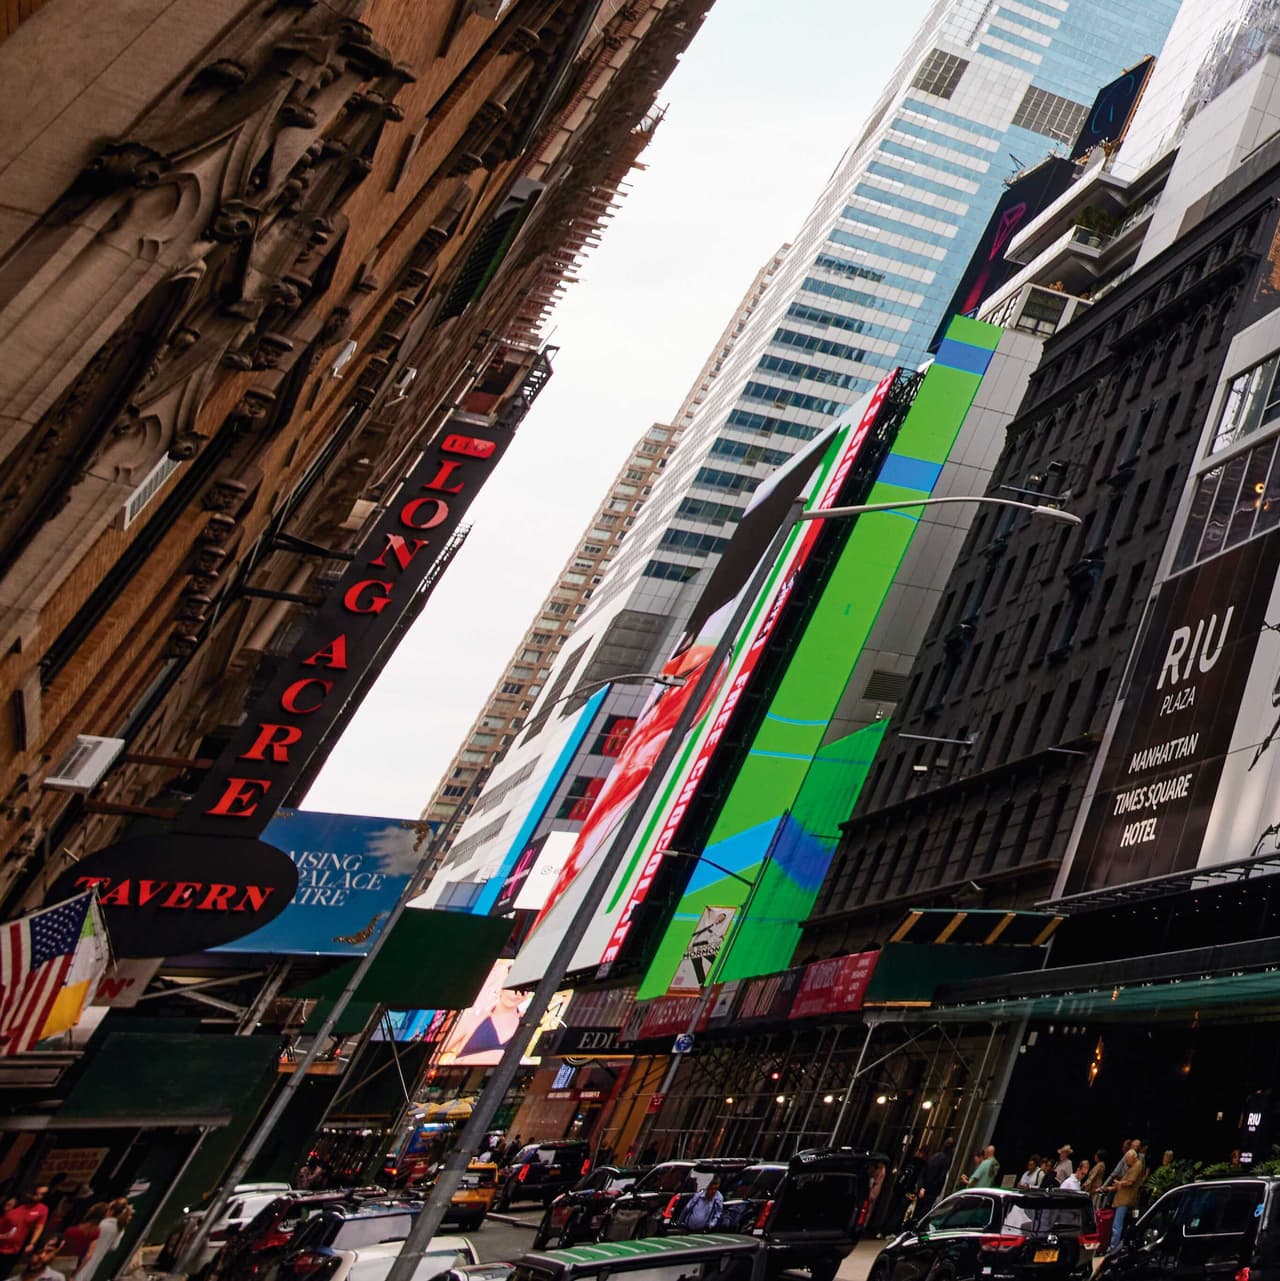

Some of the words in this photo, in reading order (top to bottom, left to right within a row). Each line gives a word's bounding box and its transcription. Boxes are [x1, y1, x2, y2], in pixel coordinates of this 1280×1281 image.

[343, 460, 464, 615] LONG
[1156, 606, 1234, 690] RIU
[1160, 686, 1196, 717] PLAZA
[206, 633, 349, 817] ACRE
[1128, 732, 1199, 774] MANHATTAN
[1113, 786, 1146, 816] TIMES
[1145, 773, 1193, 810] SQUARE
[1120, 817, 1157, 848] HOTEL
[73, 876, 275, 912] TAVERN
[683, 946, 720, 960] MORMON
[1247, 1112, 1261, 1126] RIU
